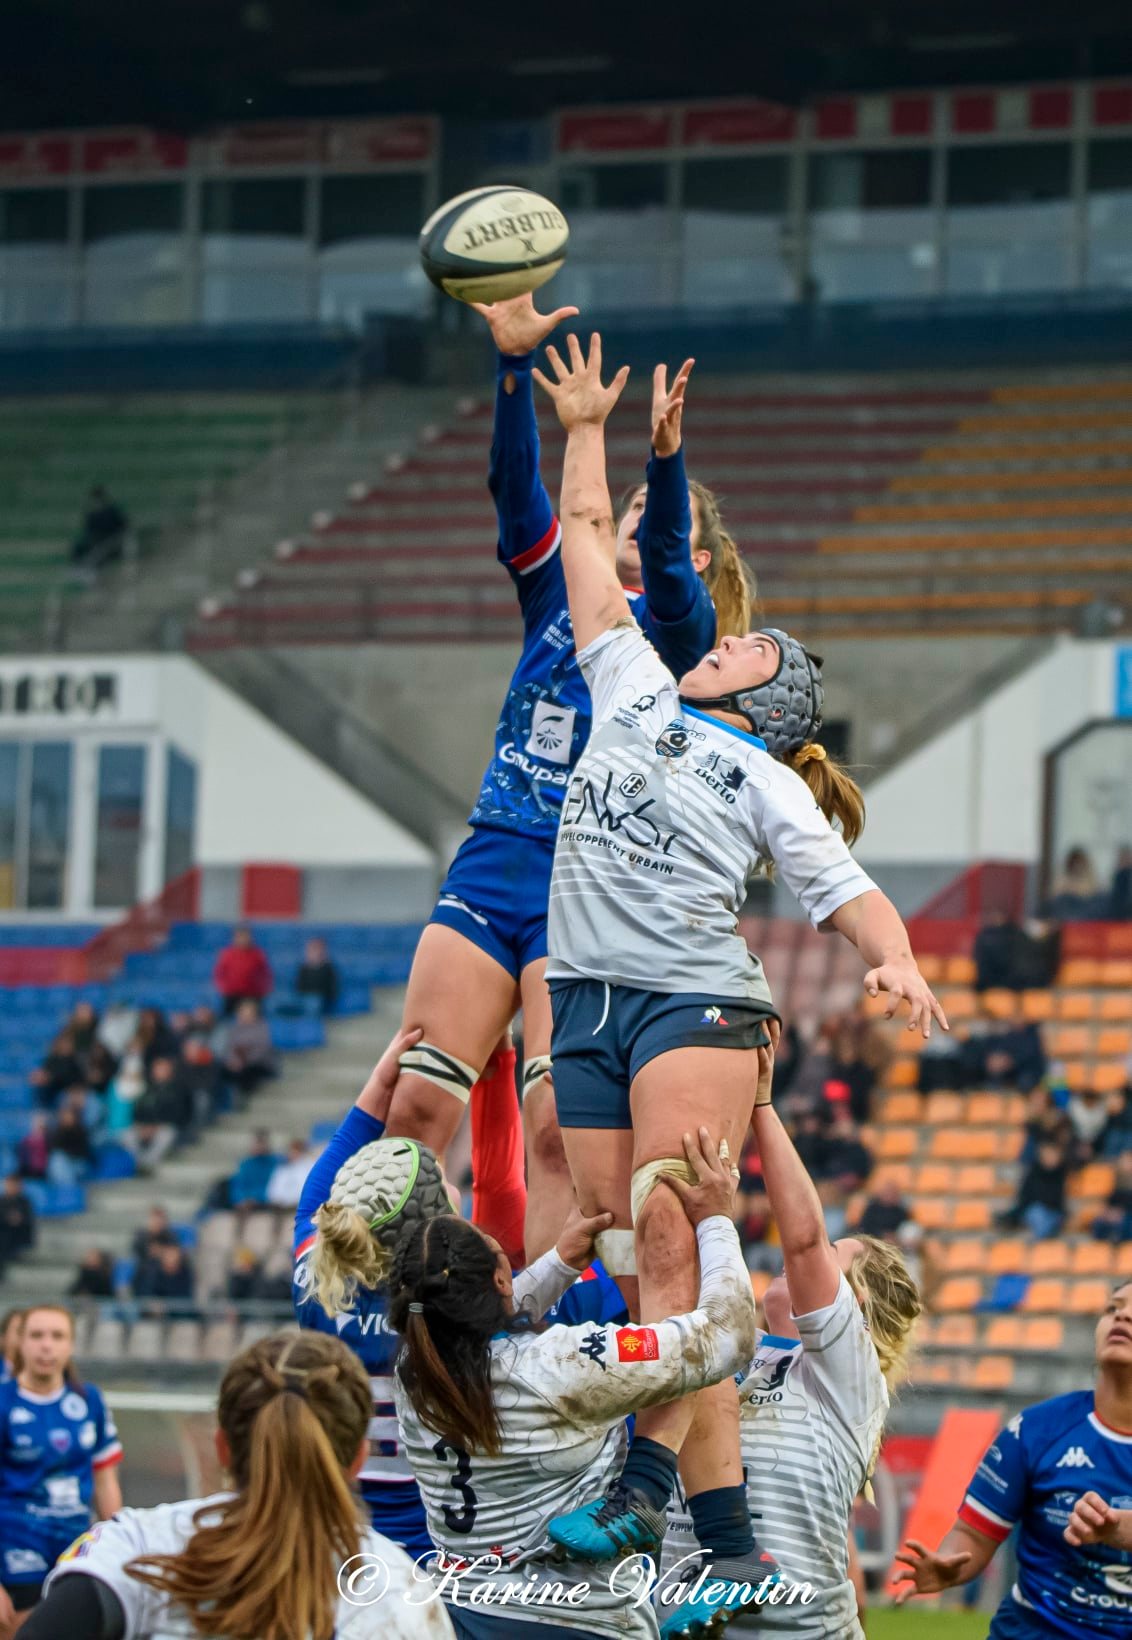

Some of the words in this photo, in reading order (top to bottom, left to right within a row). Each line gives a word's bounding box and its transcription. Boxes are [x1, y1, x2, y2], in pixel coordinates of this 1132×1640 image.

[628, 852, 674, 876] URBAIN
[747, 1391, 784, 1406] erto
[432, 1434, 478, 1534] 3
